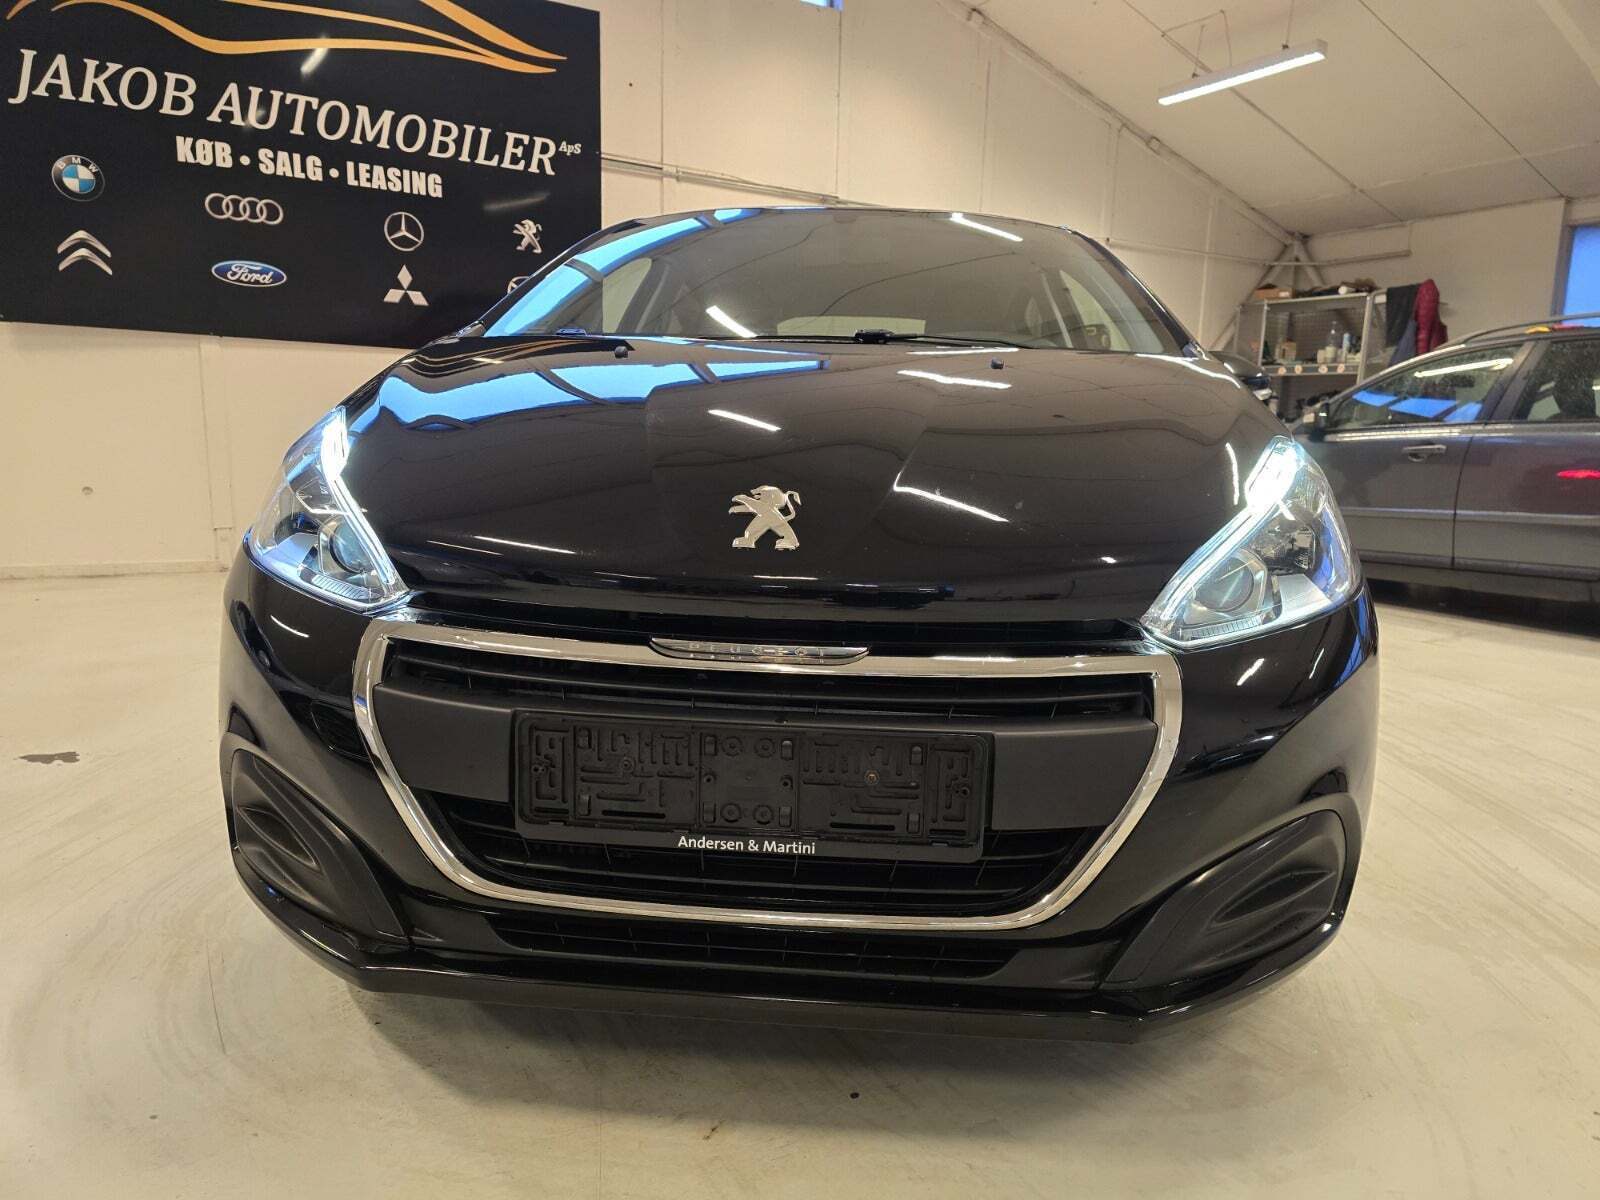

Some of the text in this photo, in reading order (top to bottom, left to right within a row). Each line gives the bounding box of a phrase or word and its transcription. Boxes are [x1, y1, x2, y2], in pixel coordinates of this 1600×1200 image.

[8, 48, 197, 116] JAKOB
[206, 82, 557, 176] AUTOMOBILER
[56, 156, 99, 173] BMW
[175, 135, 443, 198] KØB SALG LEASING
[226, 263, 274, 284] Ford
[678, 835, 816, 855] Andersen & Martini
